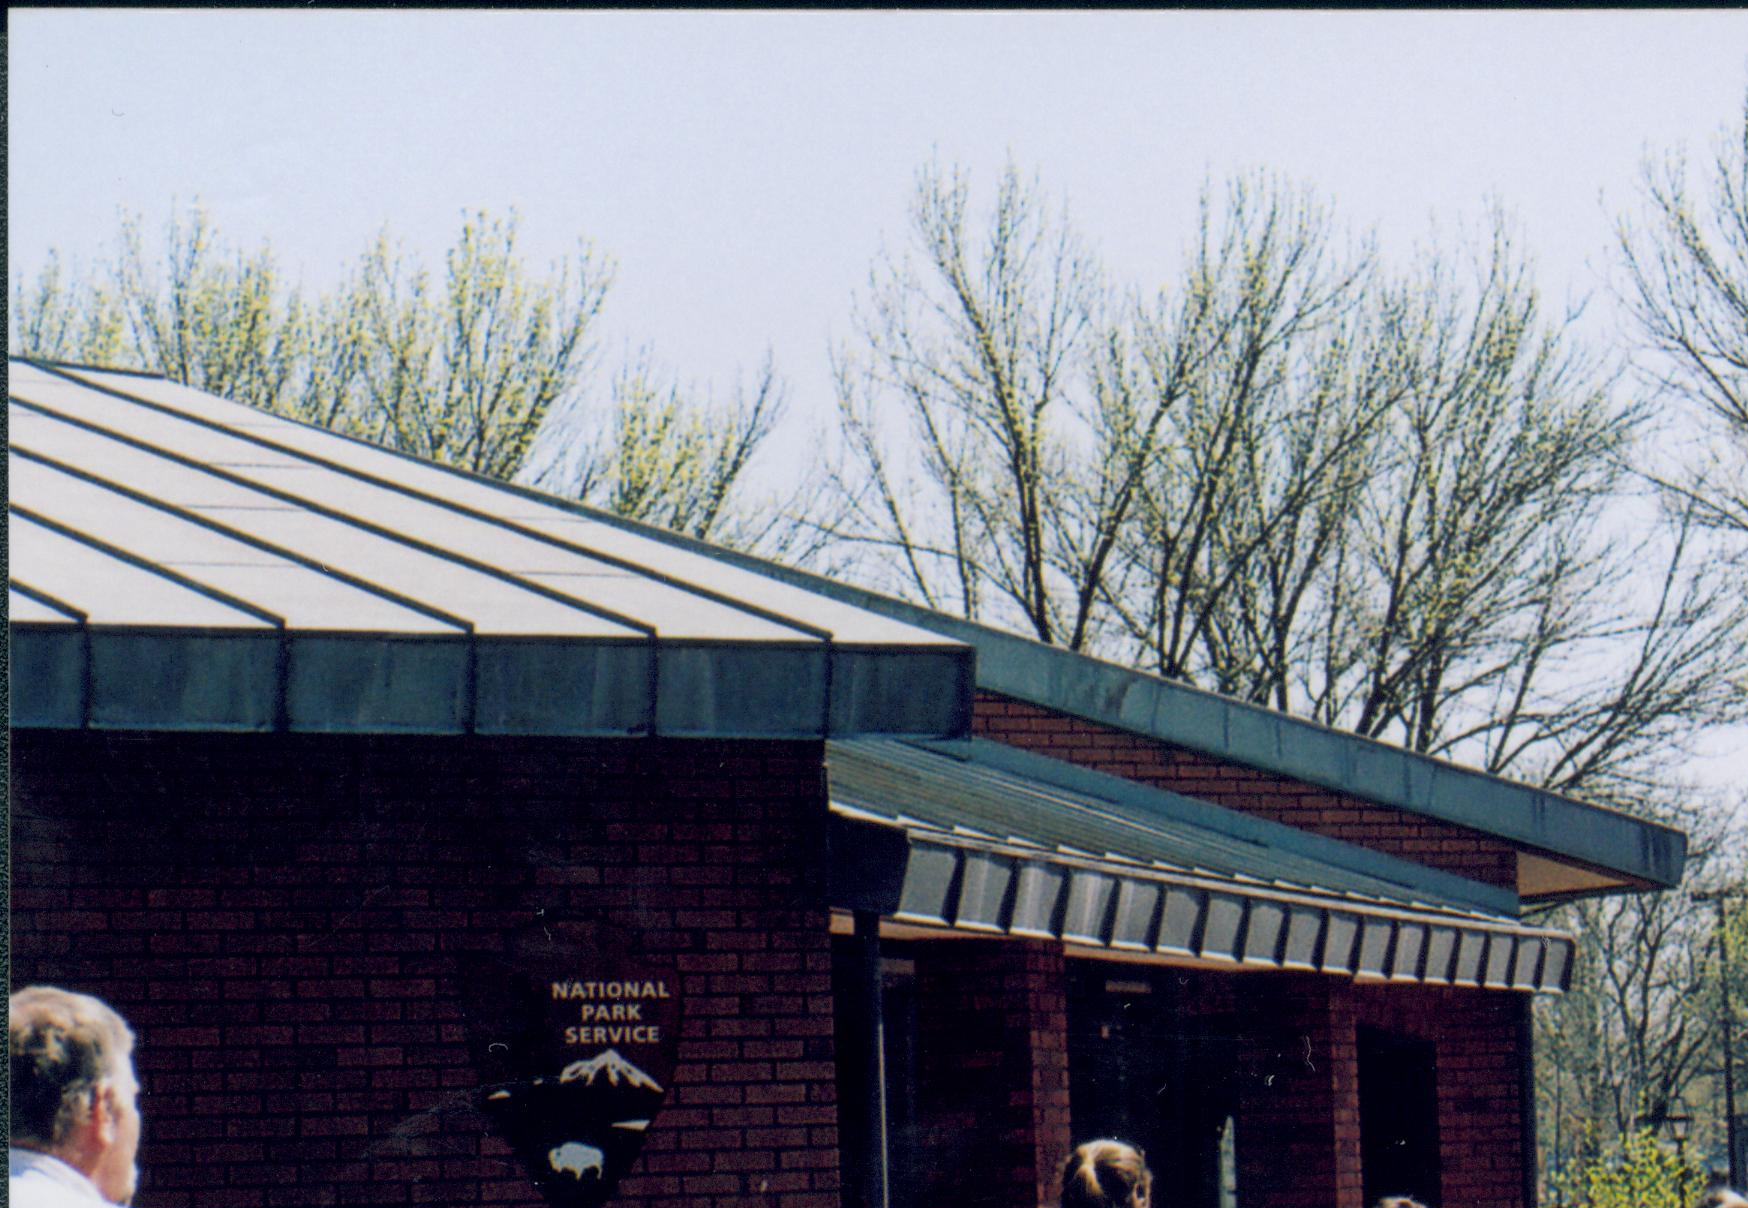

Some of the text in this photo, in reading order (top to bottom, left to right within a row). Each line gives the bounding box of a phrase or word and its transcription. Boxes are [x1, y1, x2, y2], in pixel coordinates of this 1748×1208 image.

[551, 981, 671, 999] NATIONAL
[582, 1003, 642, 1021] PARK
[565, 1026, 661, 1044] SERVICE
